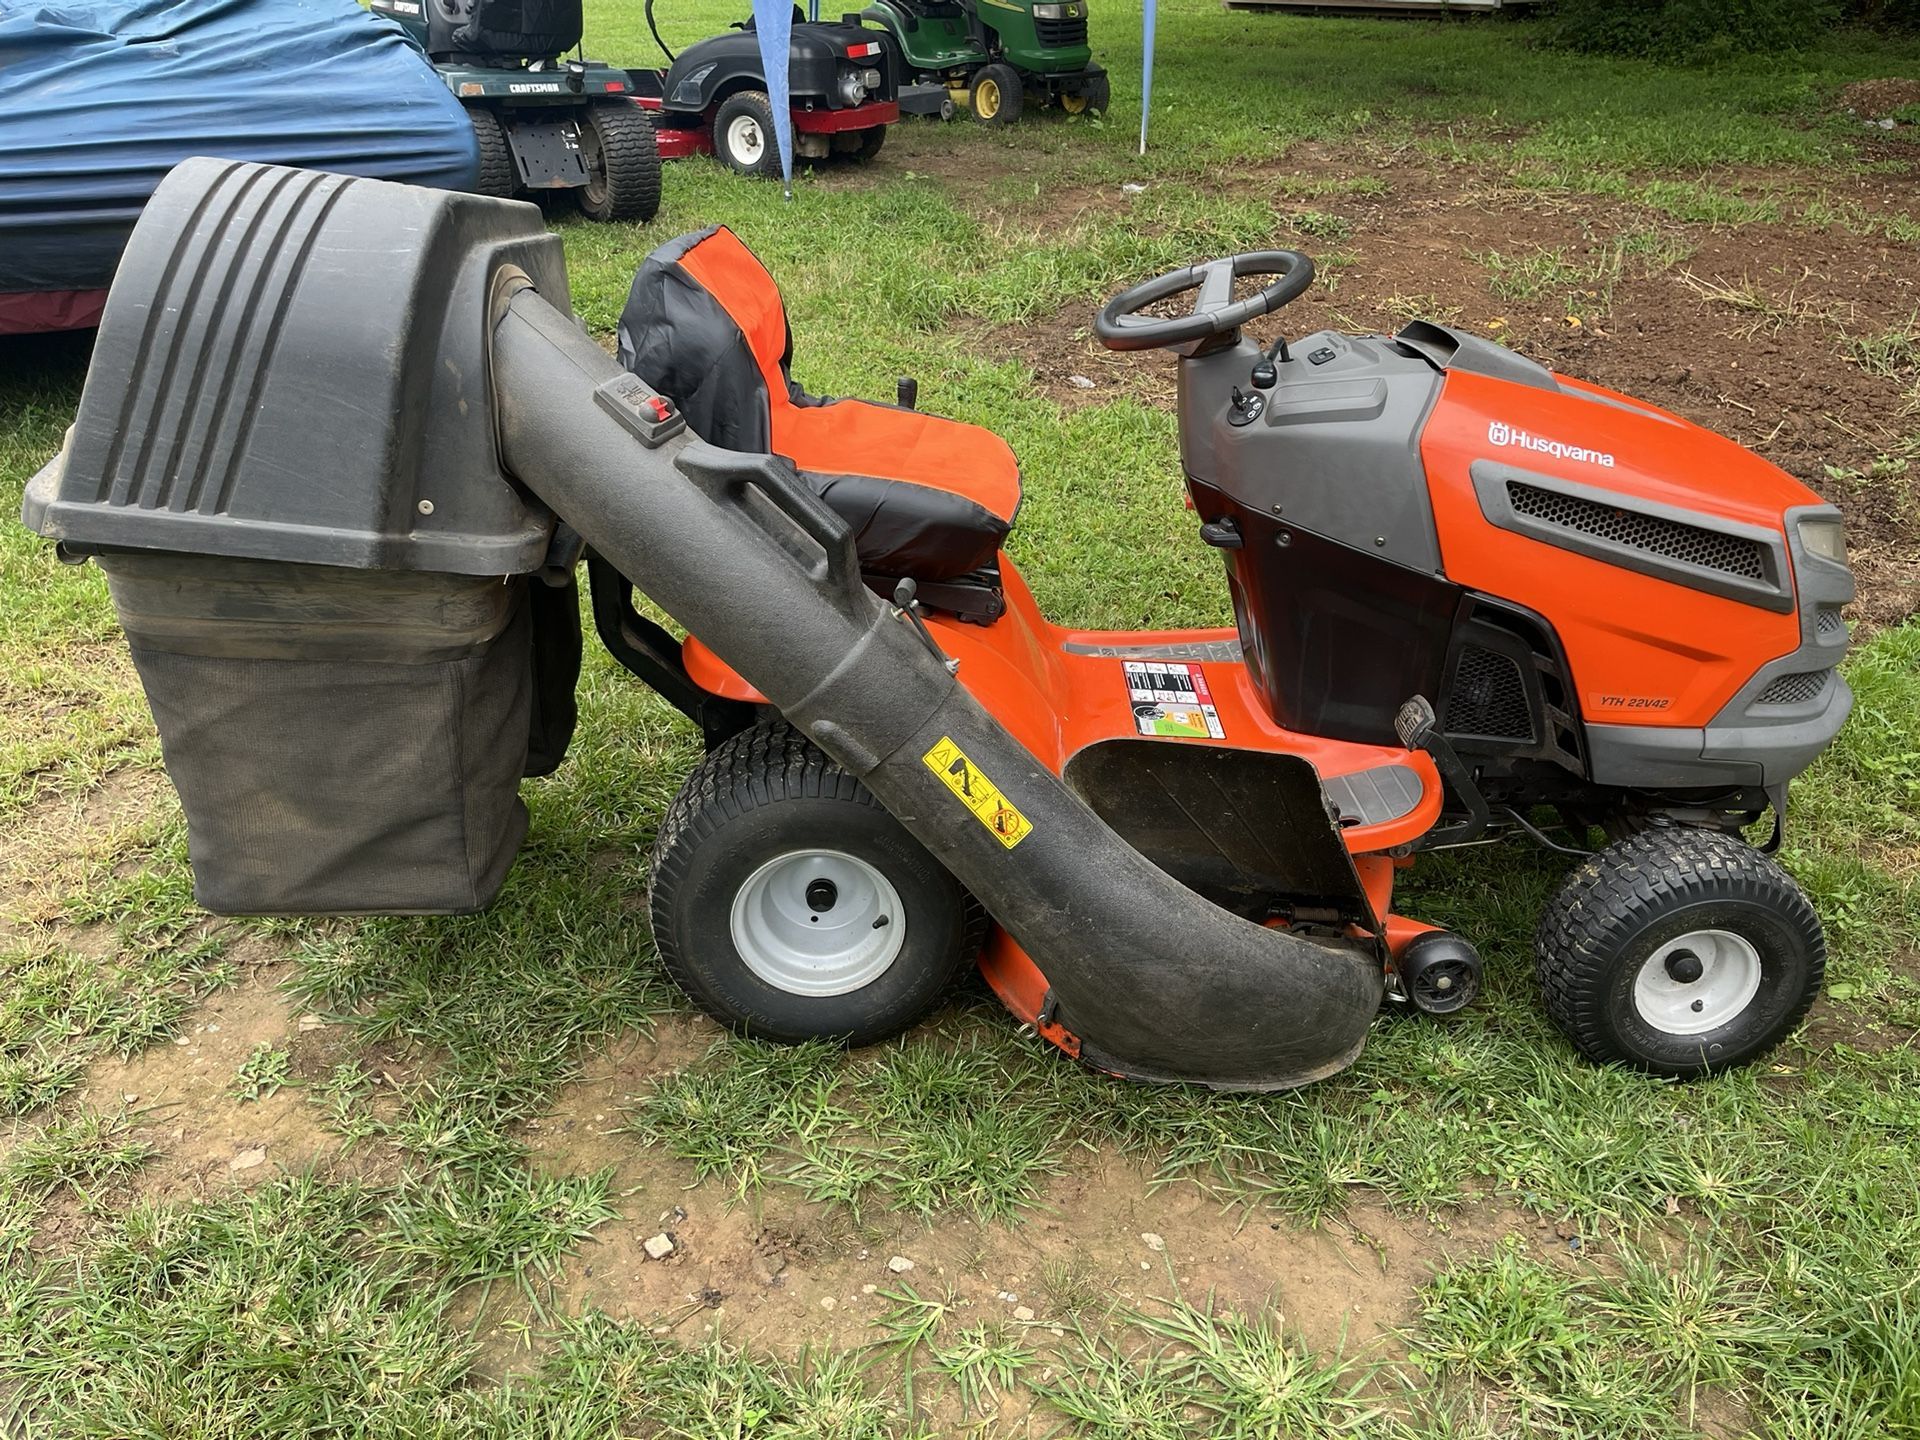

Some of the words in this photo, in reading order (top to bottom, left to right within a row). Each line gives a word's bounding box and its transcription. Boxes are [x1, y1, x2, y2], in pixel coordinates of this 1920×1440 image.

[509, 83, 560, 93] CRAFTSMAN
[1510, 429, 1615, 467] Husqvarna
[1601, 696, 1626, 707] YTH
[1627, 698, 1670, 709] 22V42
